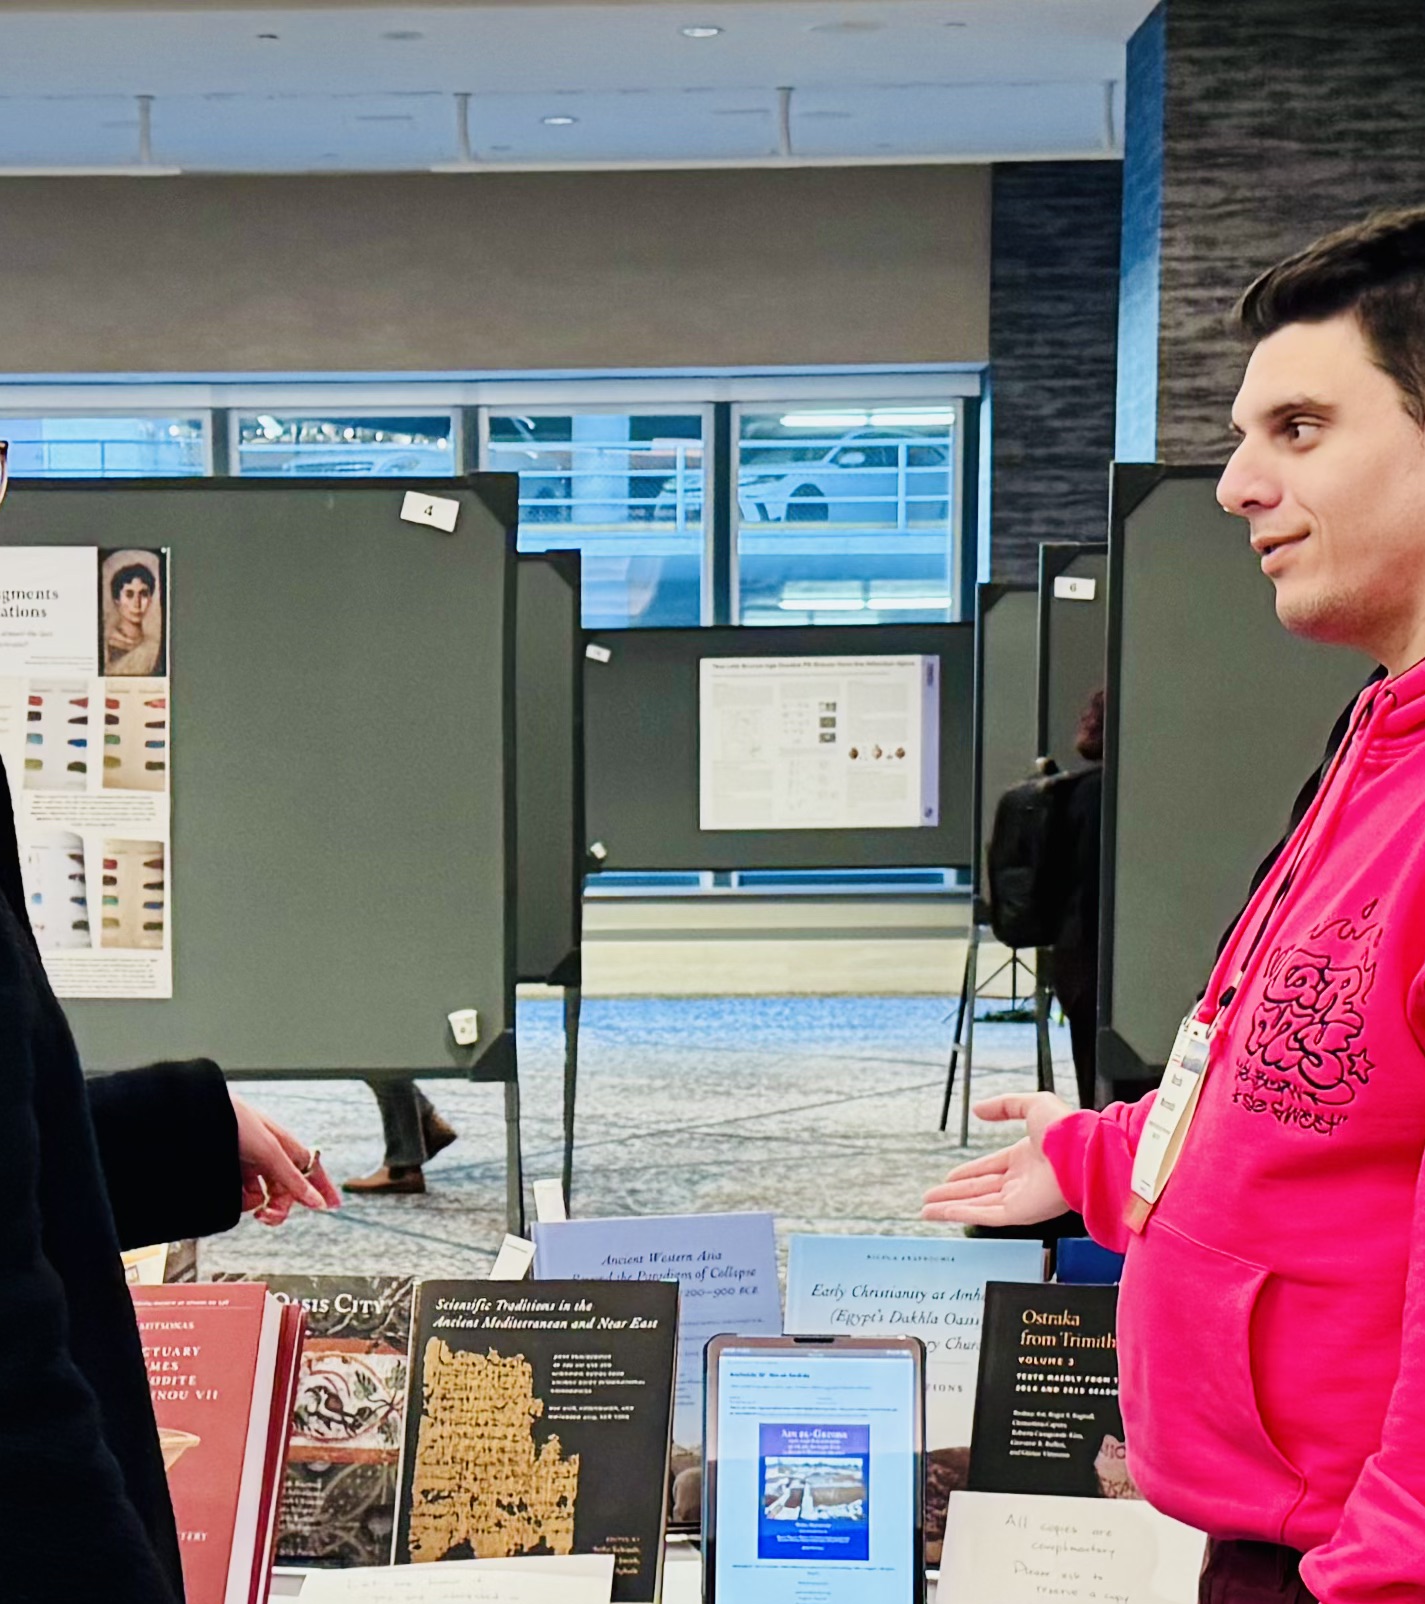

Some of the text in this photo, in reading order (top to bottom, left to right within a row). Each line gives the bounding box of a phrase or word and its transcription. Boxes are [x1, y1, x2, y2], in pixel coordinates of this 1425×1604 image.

[601, 1254, 644, 1266] Ancient
[649, 1252, 692, 1264] Western
[695, 1265, 709, 1283] of
[710, 1265, 756, 1281] Collapse
[811, 1284, 845, 1301] Early
[852, 1285, 927, 1303] Christianity
[931, 1290, 945, 1301] at
[435, 1298, 593, 1314] Scientific Traditions in the
[432, 1315, 659, 1329] Ancient Mediterranean and Near East
[889, 1310, 938, 1325] Dakhla
[1022, 1309, 1080, 1327] Ostraka
[1020, 1329, 1117, 1348] from Trimith
[142, 1346, 201, 1358] CTUARY
[1018, 1356, 1063, 1366] VOLUME
[149, 1375, 197, 1386] ODITE
[1005, 1513, 1028, 1529] All
